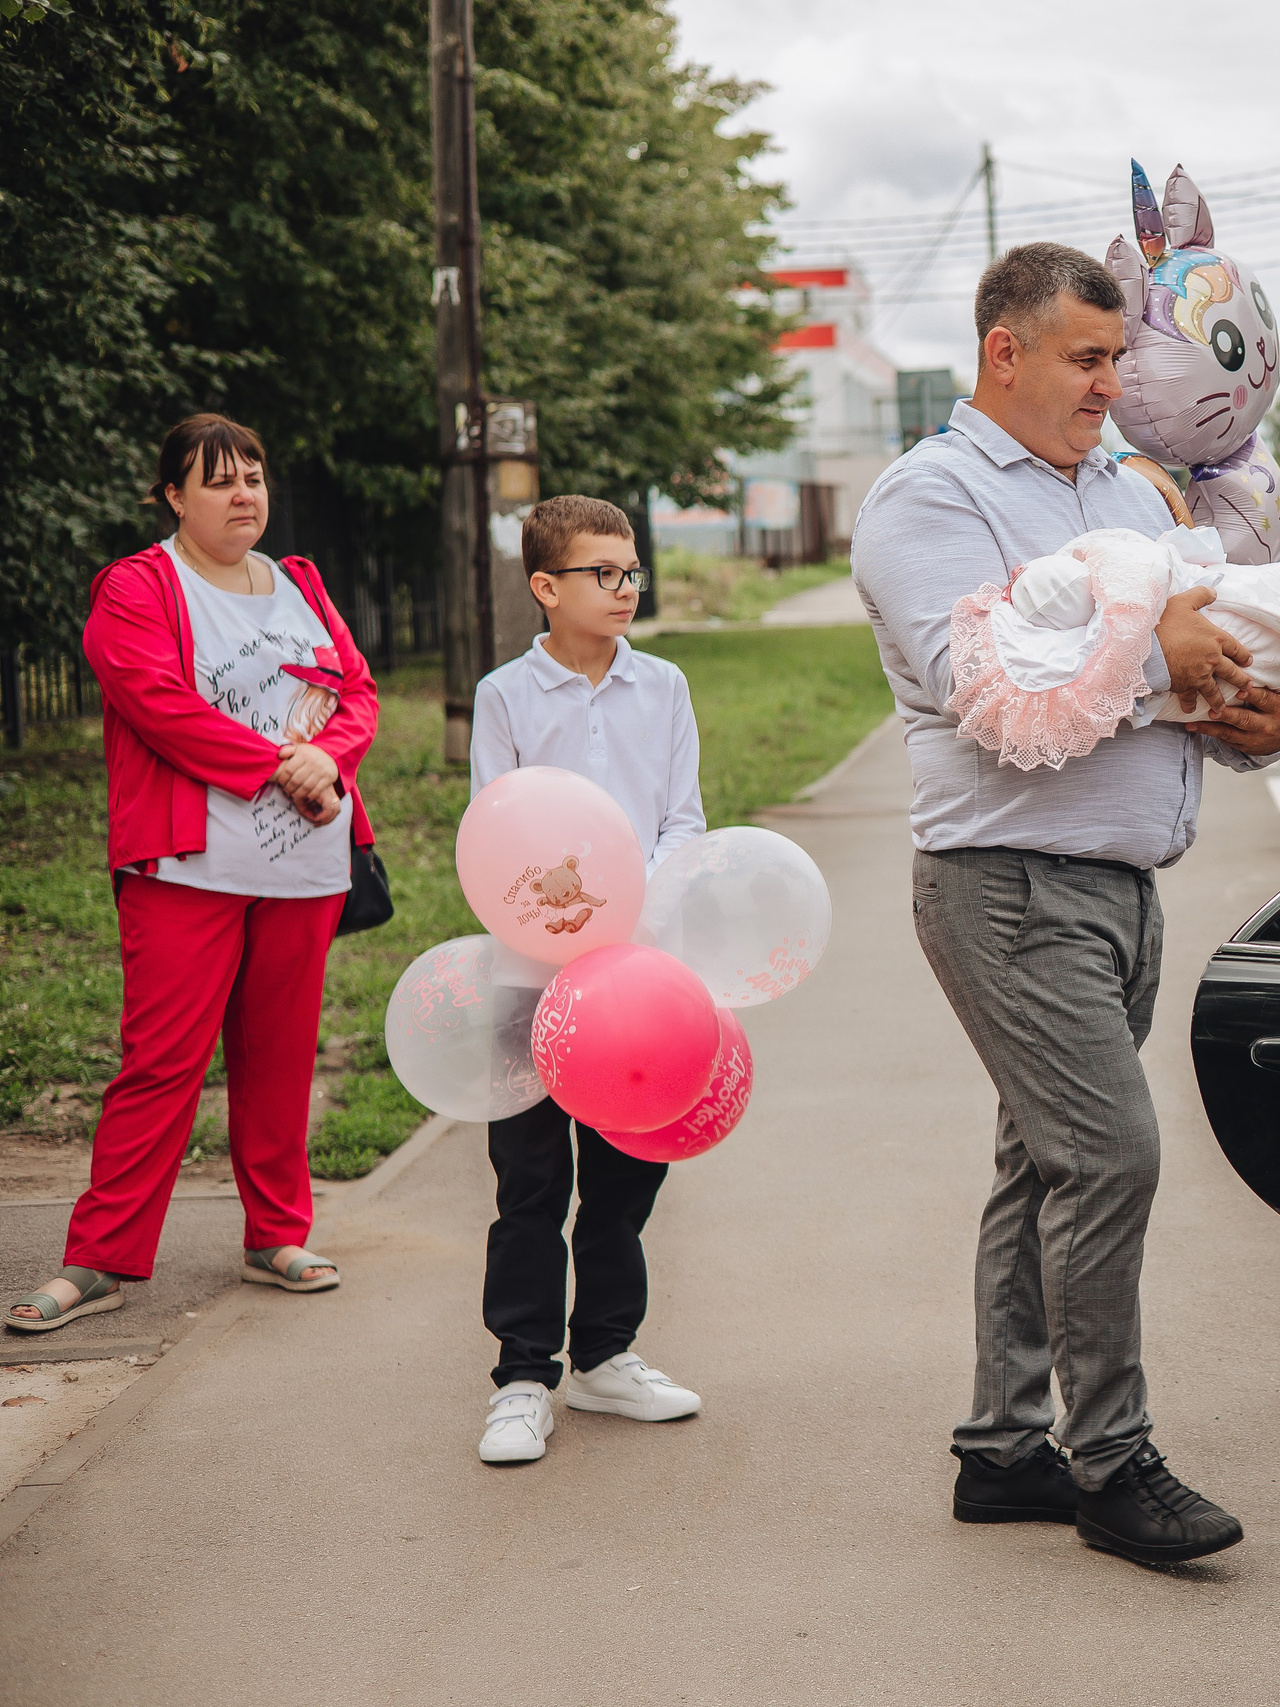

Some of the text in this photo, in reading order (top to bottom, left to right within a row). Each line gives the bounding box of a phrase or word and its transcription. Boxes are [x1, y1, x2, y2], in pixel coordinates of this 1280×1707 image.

[207, 659, 235, 695] you
[239, 639, 262, 658] are
[259, 667, 286, 694] one
[503, 865, 542, 905] Спасибо
[520, 900, 531, 909] за
